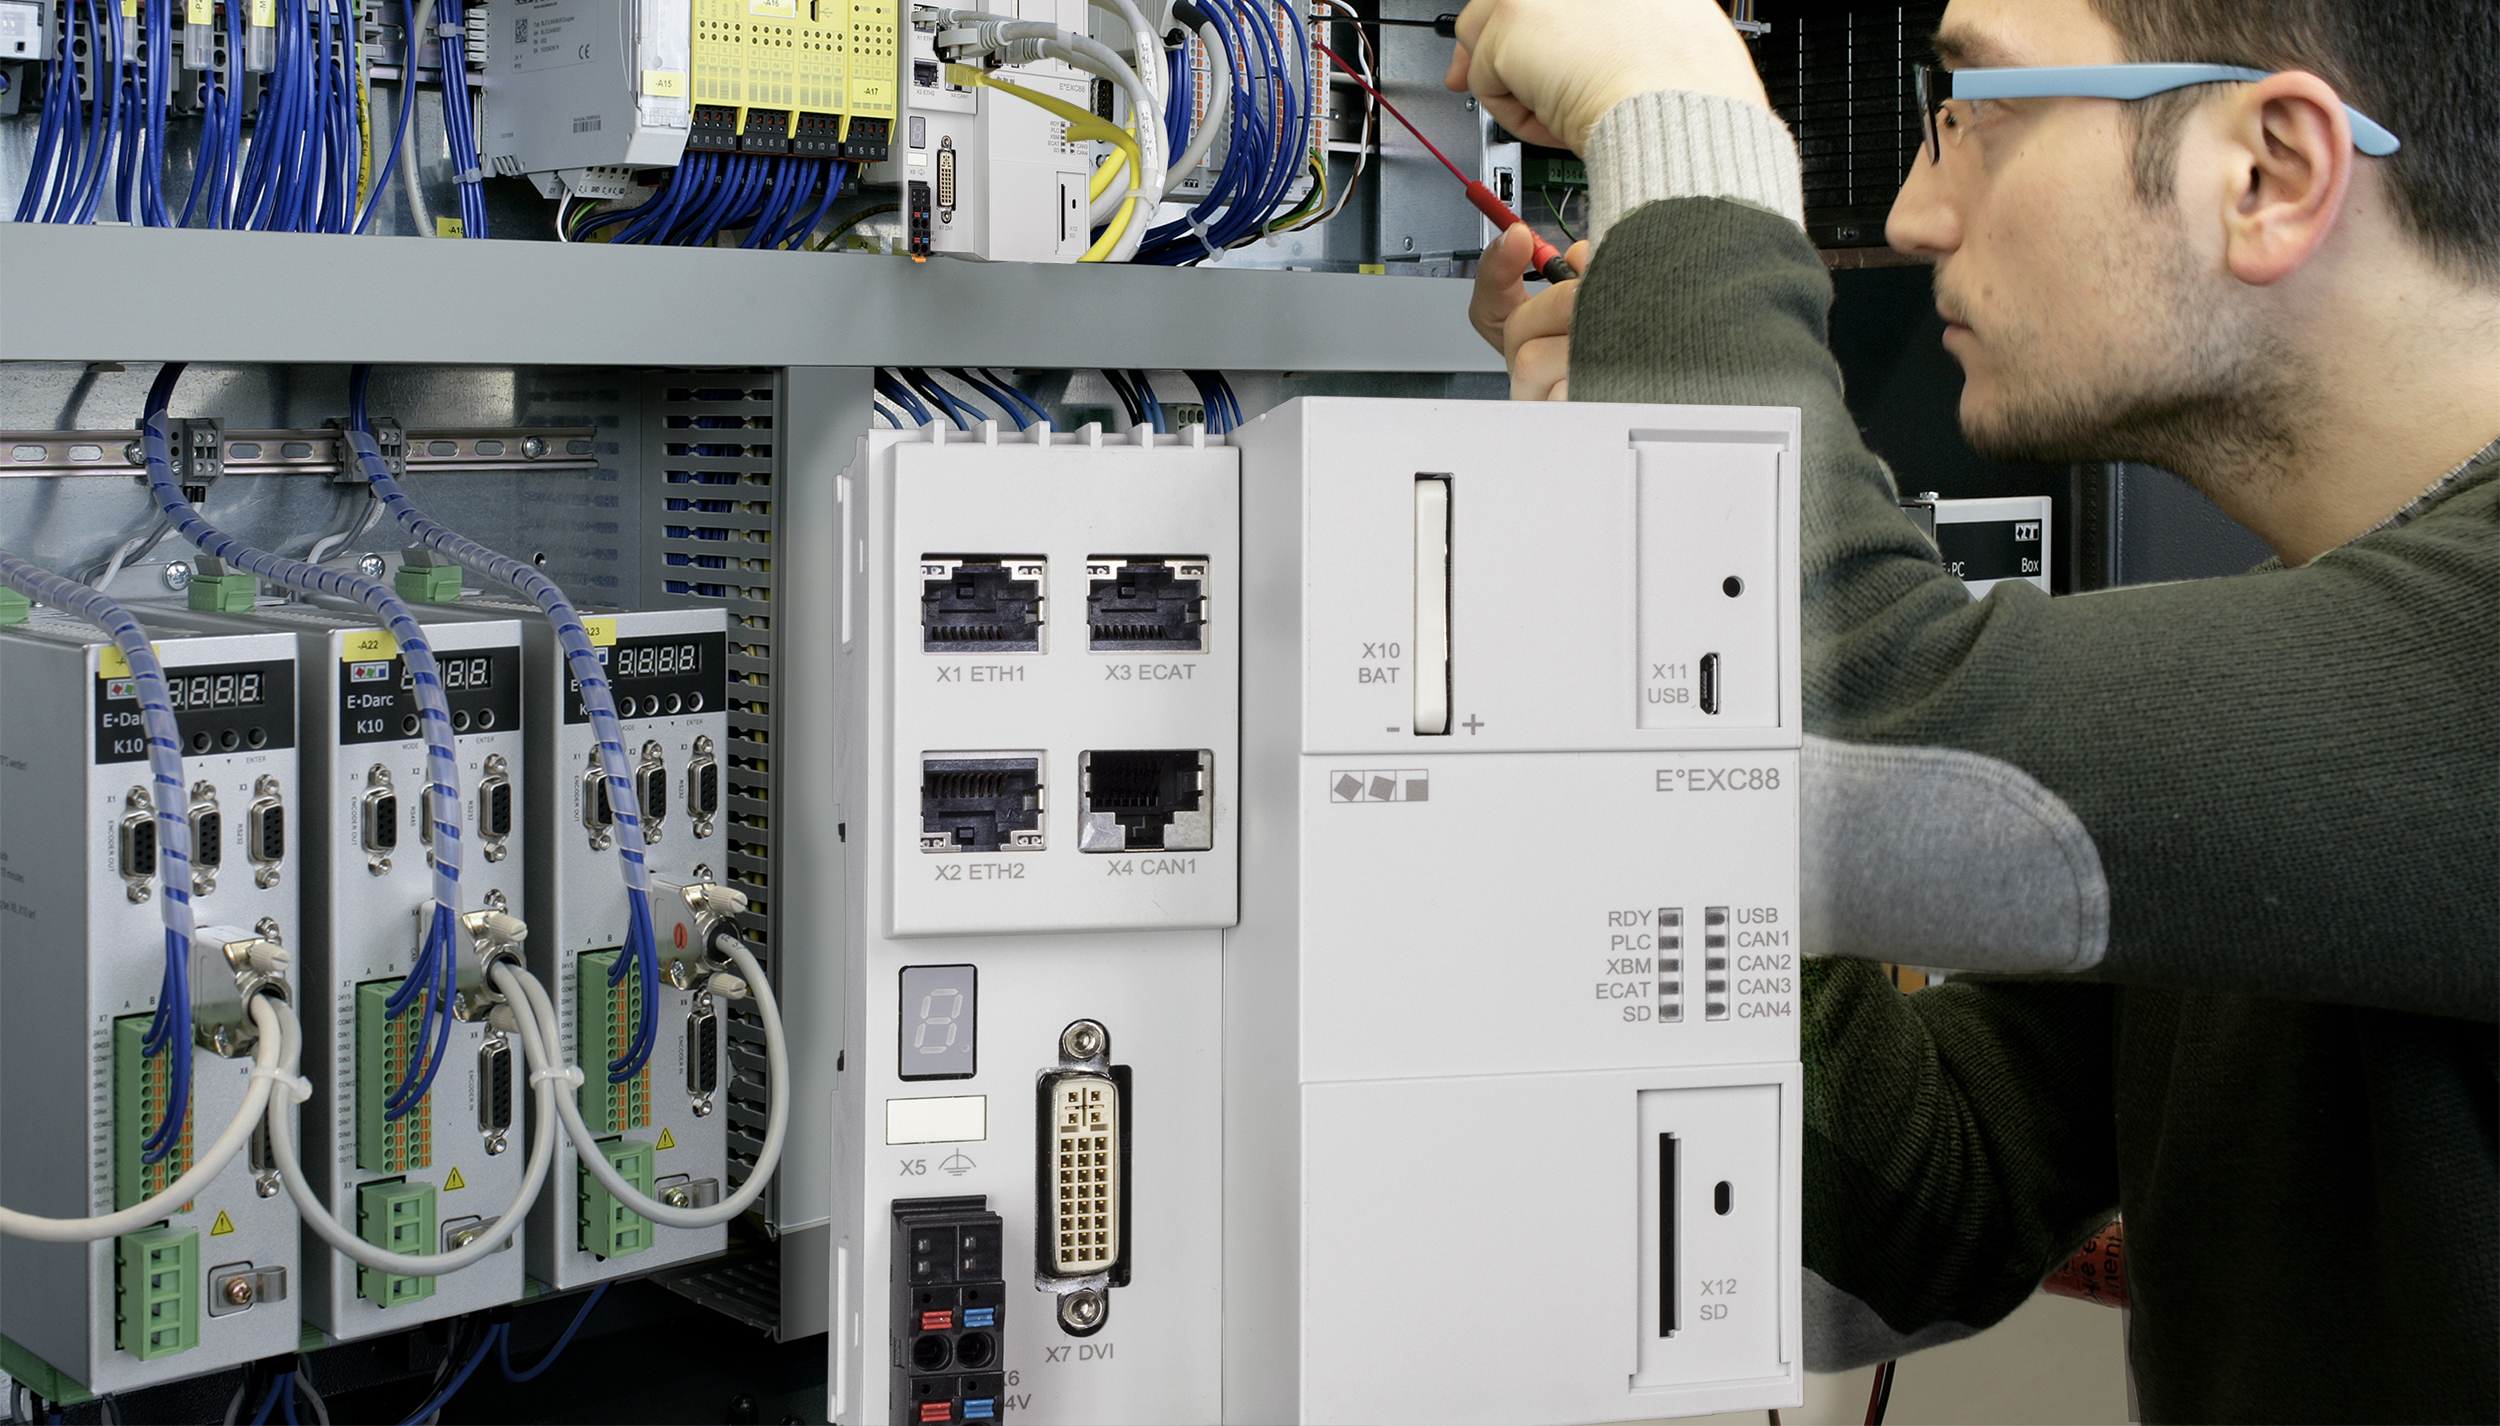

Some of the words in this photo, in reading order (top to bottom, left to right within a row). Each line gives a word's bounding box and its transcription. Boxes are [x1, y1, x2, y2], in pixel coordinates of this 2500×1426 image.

[655, 80, 672, 88] -A15
[864, 87, 878, 96] -A17
[2021, 557, 2039, 573] Box
[357, 640, 378, 650] -A22
[1362, 643, 1401, 660] X10
[936, 666, 962, 683] X1
[970, 665, 1027, 683] ETH1
[1105, 664, 1132, 681] X3
[1139, 663, 1197, 681] ECAT
[1358, 667, 1400, 684] BAT
[1652, 663, 1688, 680] X11
[1647, 687, 1690, 704] USB
[357, 718, 384, 734] K10
[686, 718, 704, 726] ENTER
[114, 737, 144, 754] K10
[476, 736, 495, 744] ENTER
[246, 755, 267, 763] ENTER
[239, 784, 248, 792] X3
[934, 864, 962, 882] X2
[969, 863, 1026, 881] ETH2
[1106, 859, 1134, 876] X4
[1140, 858, 1197, 876] CAN1
[1608, 909, 1652, 927] RDY
[1737, 908, 1778, 925] USB
[586, 937, 592, 945] A
[607, 934, 612, 942] B
[1611, 934, 1651, 951] PLC
[1737, 930, 1790, 948] CAN1
[566, 949, 574, 957] X7
[388, 964, 394, 972] B
[1606, 957, 1652, 976] XBM
[1737, 954, 1792, 972] CAN2
[1595, 981, 1652, 1000] ECAT
[1737, 977, 1792, 995] CAN3
[124, 1000, 130, 1009] A
[150, 997, 156, 1006] B
[1737, 1000, 1792, 1019] CAN4
[99, 1014, 108, 1022] X7
[1622, 1005, 1651, 1022] SD
[900, 1159, 927, 1176] X5
[1700, 1278, 1738, 1297] X12
[1700, 1303, 1728, 1321] SD
[1045, 1346, 1072, 1363] X7
[1079, 1344, 1114, 1361] DVI
